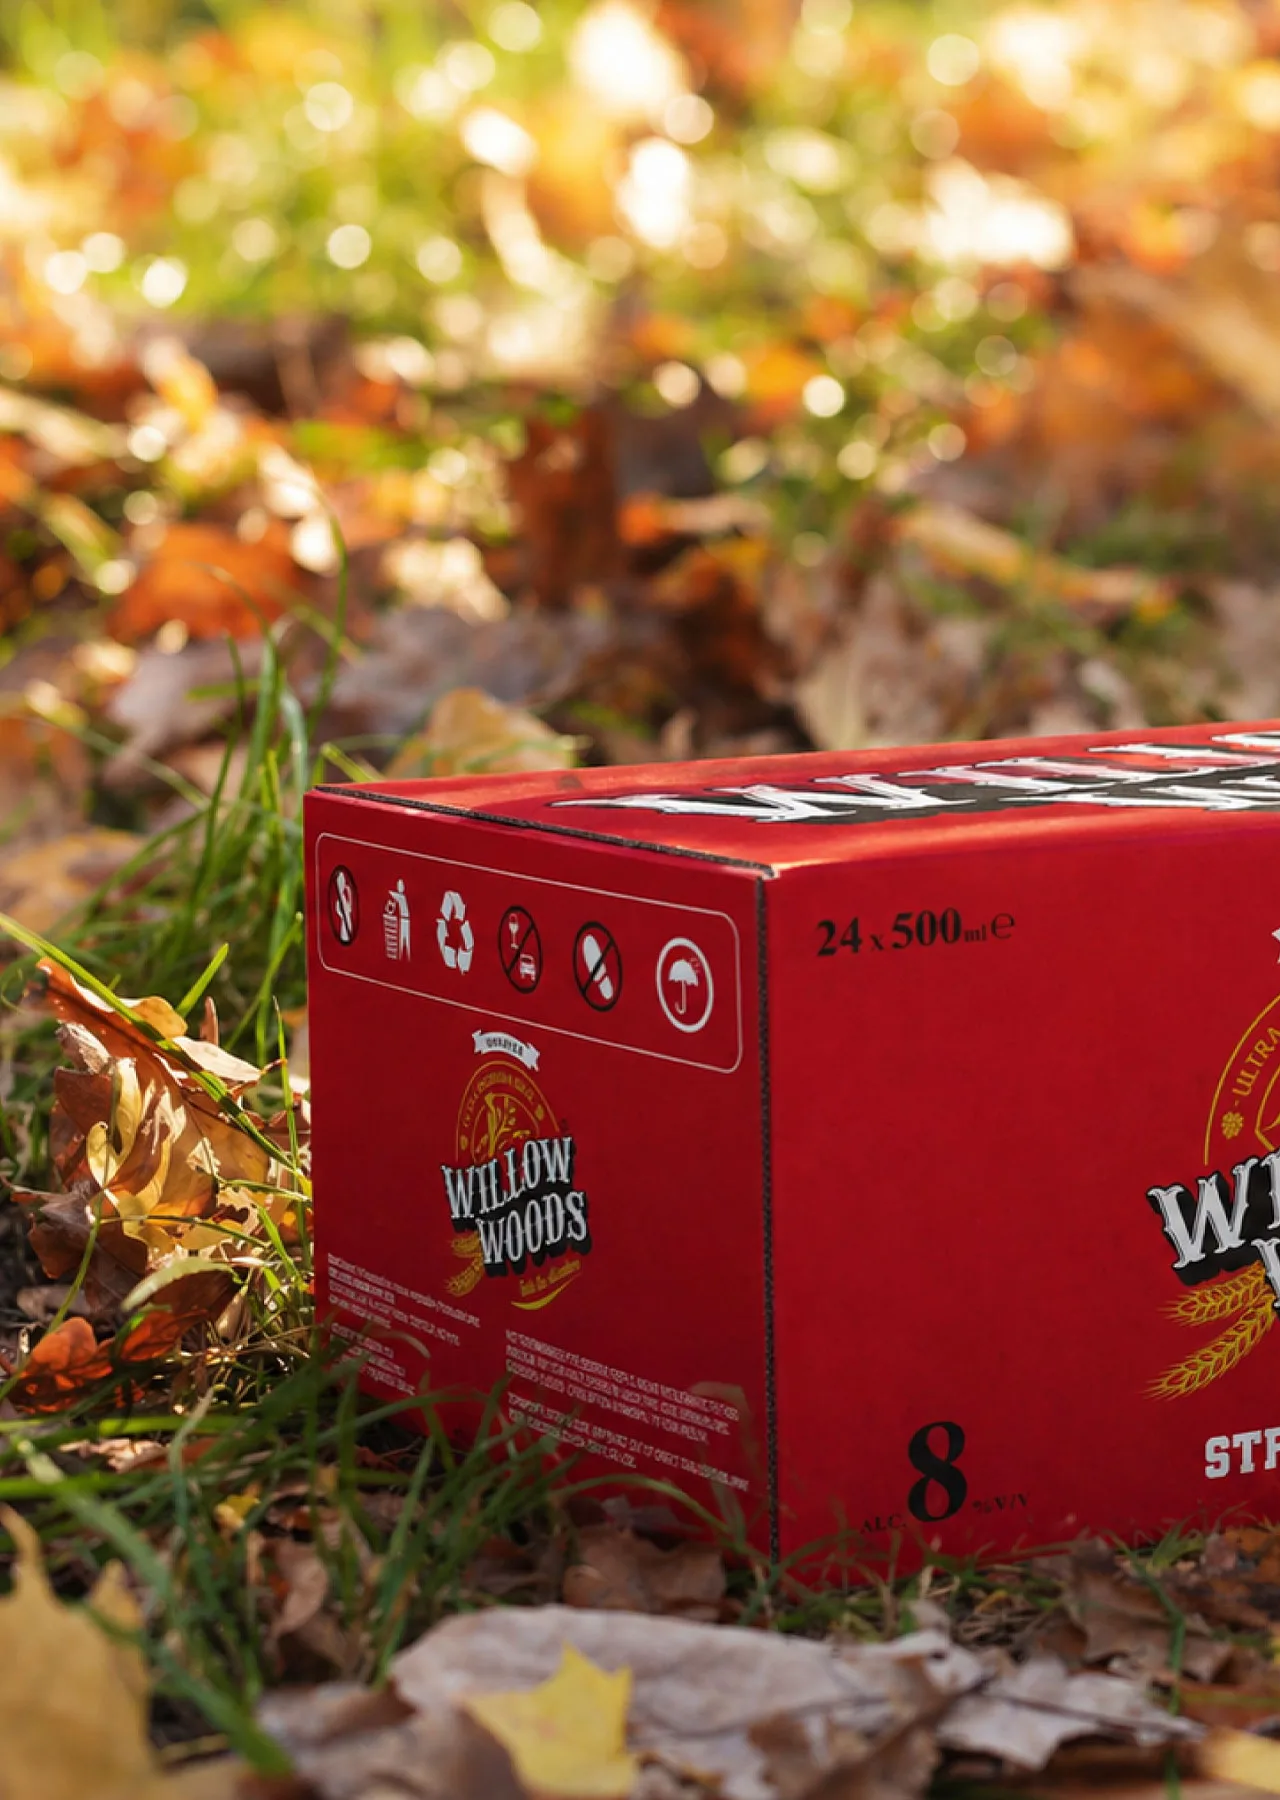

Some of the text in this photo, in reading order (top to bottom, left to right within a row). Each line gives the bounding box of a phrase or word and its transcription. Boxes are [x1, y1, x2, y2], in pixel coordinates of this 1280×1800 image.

[816, 909, 863, 957] 24
[440, 1136, 573, 1218] WILLOW
[475, 1191, 587, 1264] WOODS
[907, 1420, 968, 1523] 8
